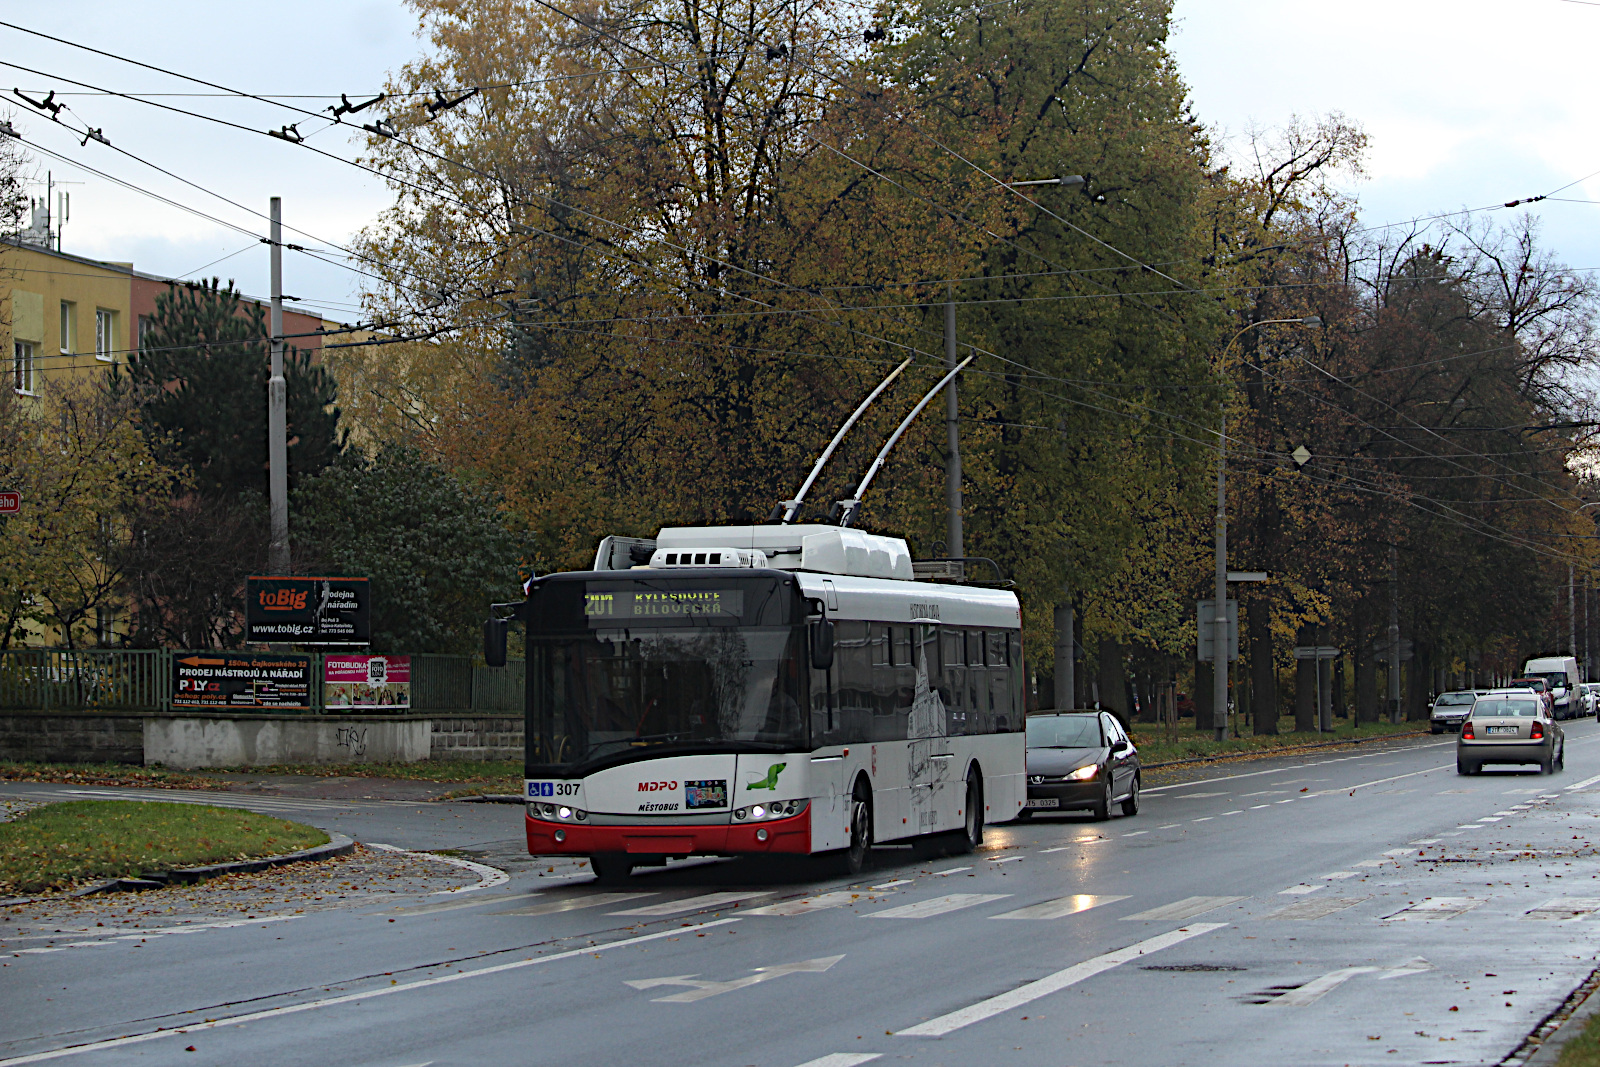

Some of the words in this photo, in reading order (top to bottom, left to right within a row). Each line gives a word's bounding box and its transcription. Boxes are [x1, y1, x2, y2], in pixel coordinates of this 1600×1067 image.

[259, 588, 308, 610] toBig
[584, 594, 613, 615] 201
[634, 602, 721, 615] BÍLOVECKÁ
[252, 624, 314, 635] www.tobig.cz
[251, 658, 297, 668] Čajkovského
[180, 668, 213, 677] PRODEJ
[215, 667, 260, 678] NÁSTROJŮ
[262, 669, 268, 678] A
[270, 668, 303, 678] NÁŘADÍ
[180, 678, 220, 691] POLY.cz
[556, 783, 581, 796] 307
[637, 780, 678, 792] MDPO
[638, 801, 679, 812] MĚSTOBUS
